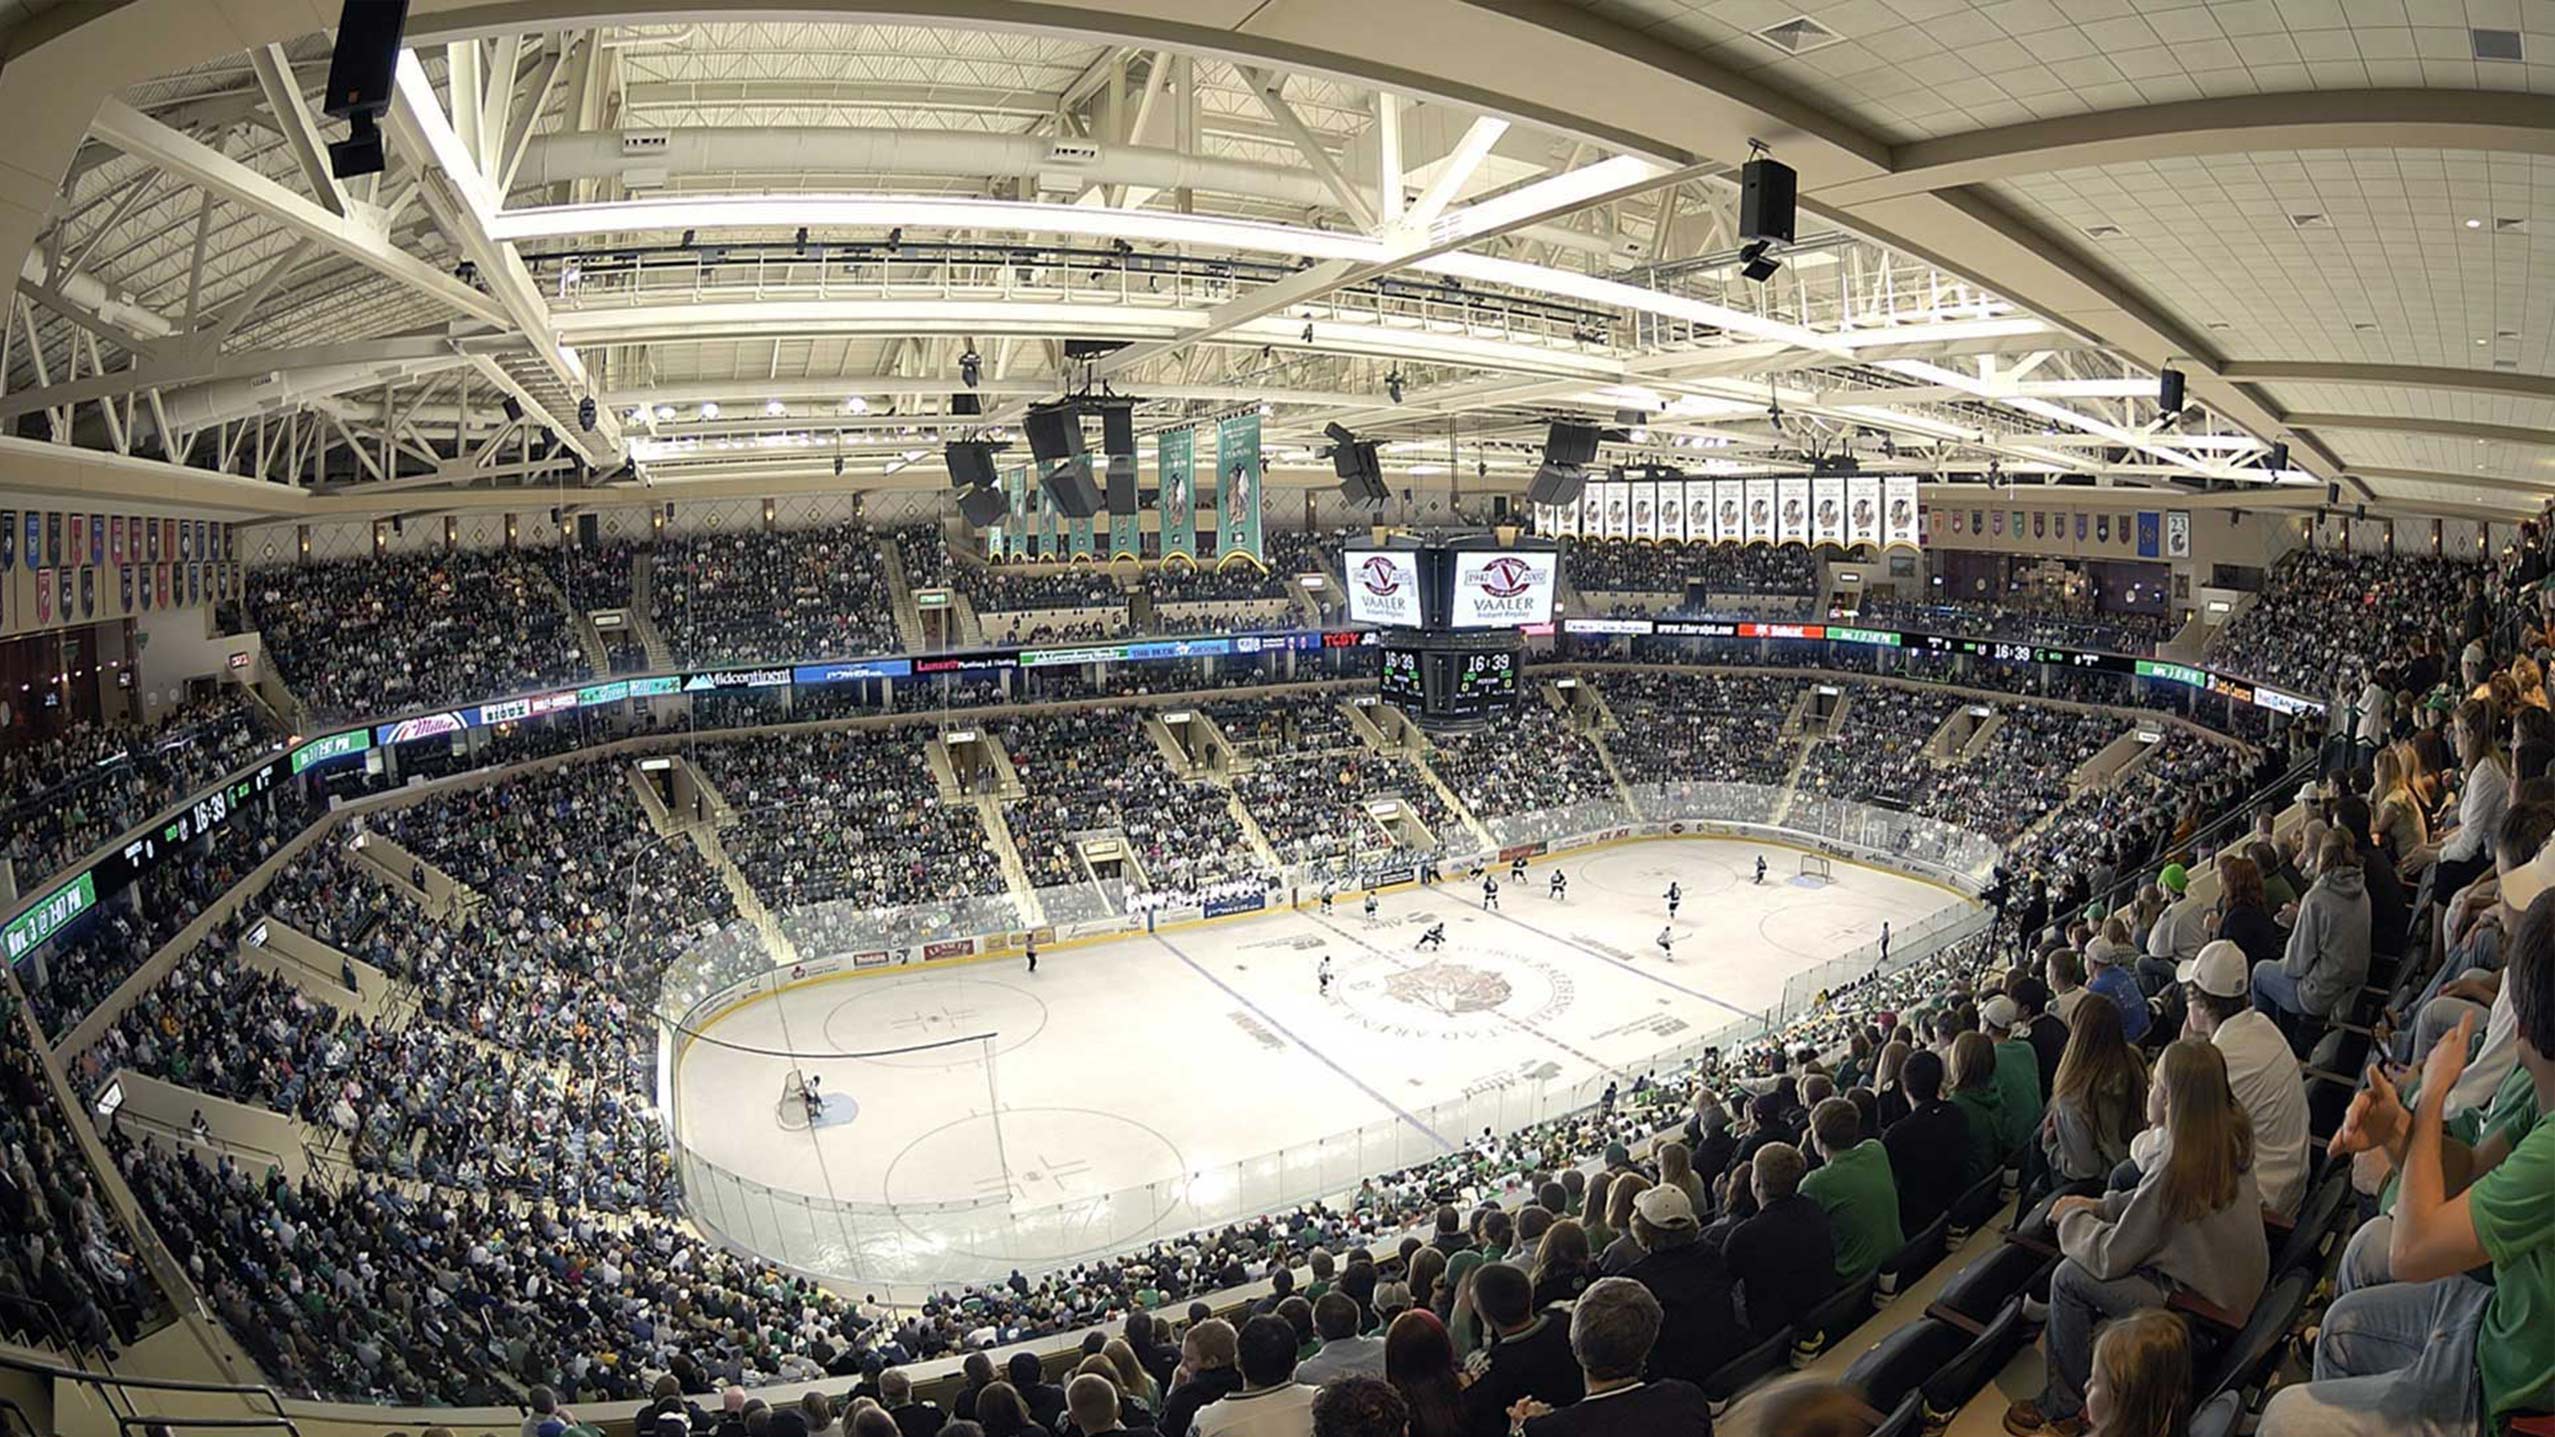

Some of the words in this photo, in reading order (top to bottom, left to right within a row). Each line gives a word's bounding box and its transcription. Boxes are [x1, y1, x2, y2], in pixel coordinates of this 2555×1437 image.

[1361, 596, 1406, 610] VAALER
[1473, 598, 1535, 611] VAALER
[1994, 643, 2031, 662] 16:39
[1384, 651, 1415, 671] 16:39
[1466, 653, 1511, 674] 16:39
[1461, 682, 1470, 693] 0
[1504, 678, 1513, 689] 0
[192, 792, 227, 834] 16:39
